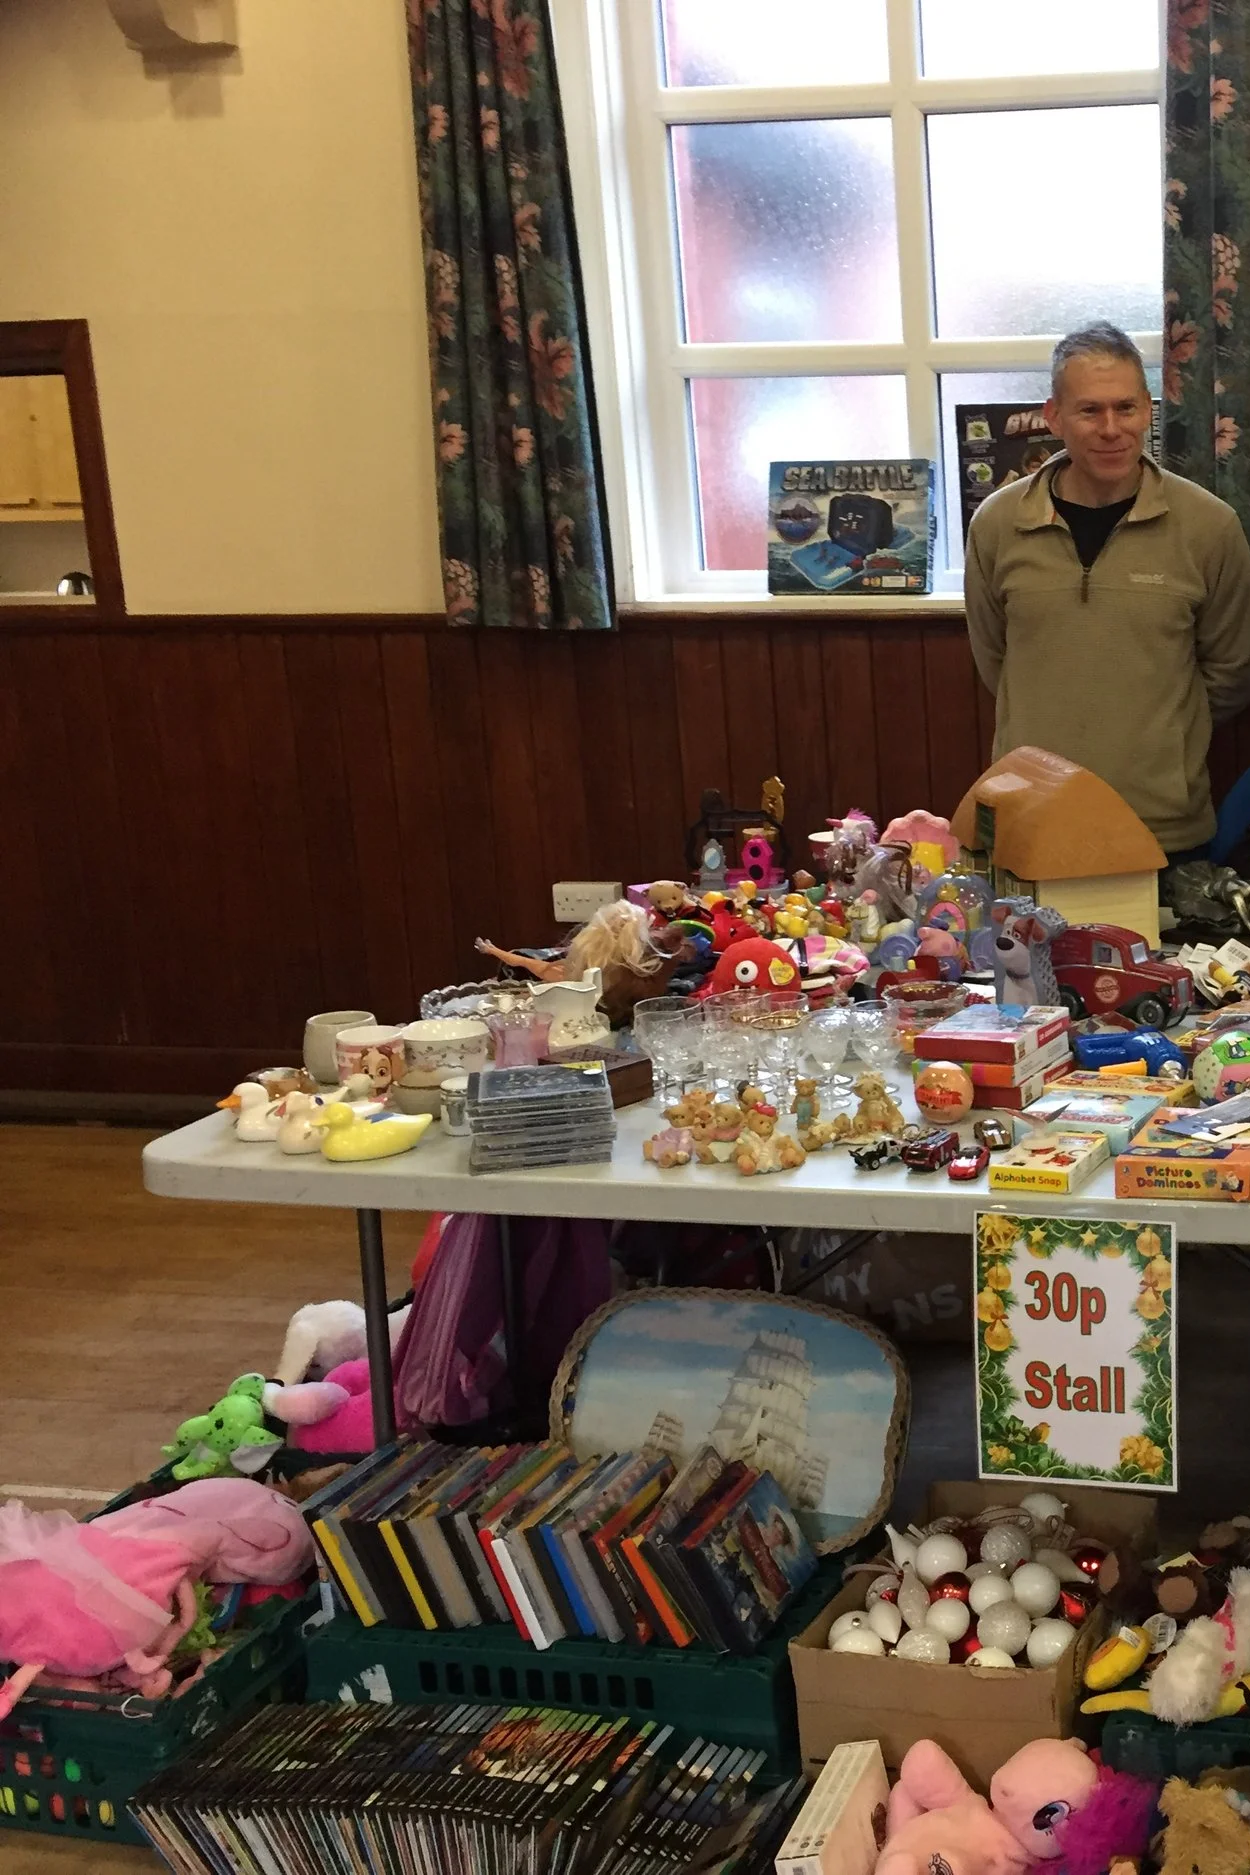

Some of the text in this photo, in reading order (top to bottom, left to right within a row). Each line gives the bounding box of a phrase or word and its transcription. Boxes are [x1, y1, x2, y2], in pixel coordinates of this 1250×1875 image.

[782, 464, 918, 492] SEA BATTLE
[994, 1172, 1062, 1187] Alphabet Snap
[1145, 1165, 1193, 1178] Picture
[1136, 1177, 1201, 1190] Dominoes
[1024, 1269, 1107, 1336] 30p
[1024, 1360, 1126, 1414] Stall
